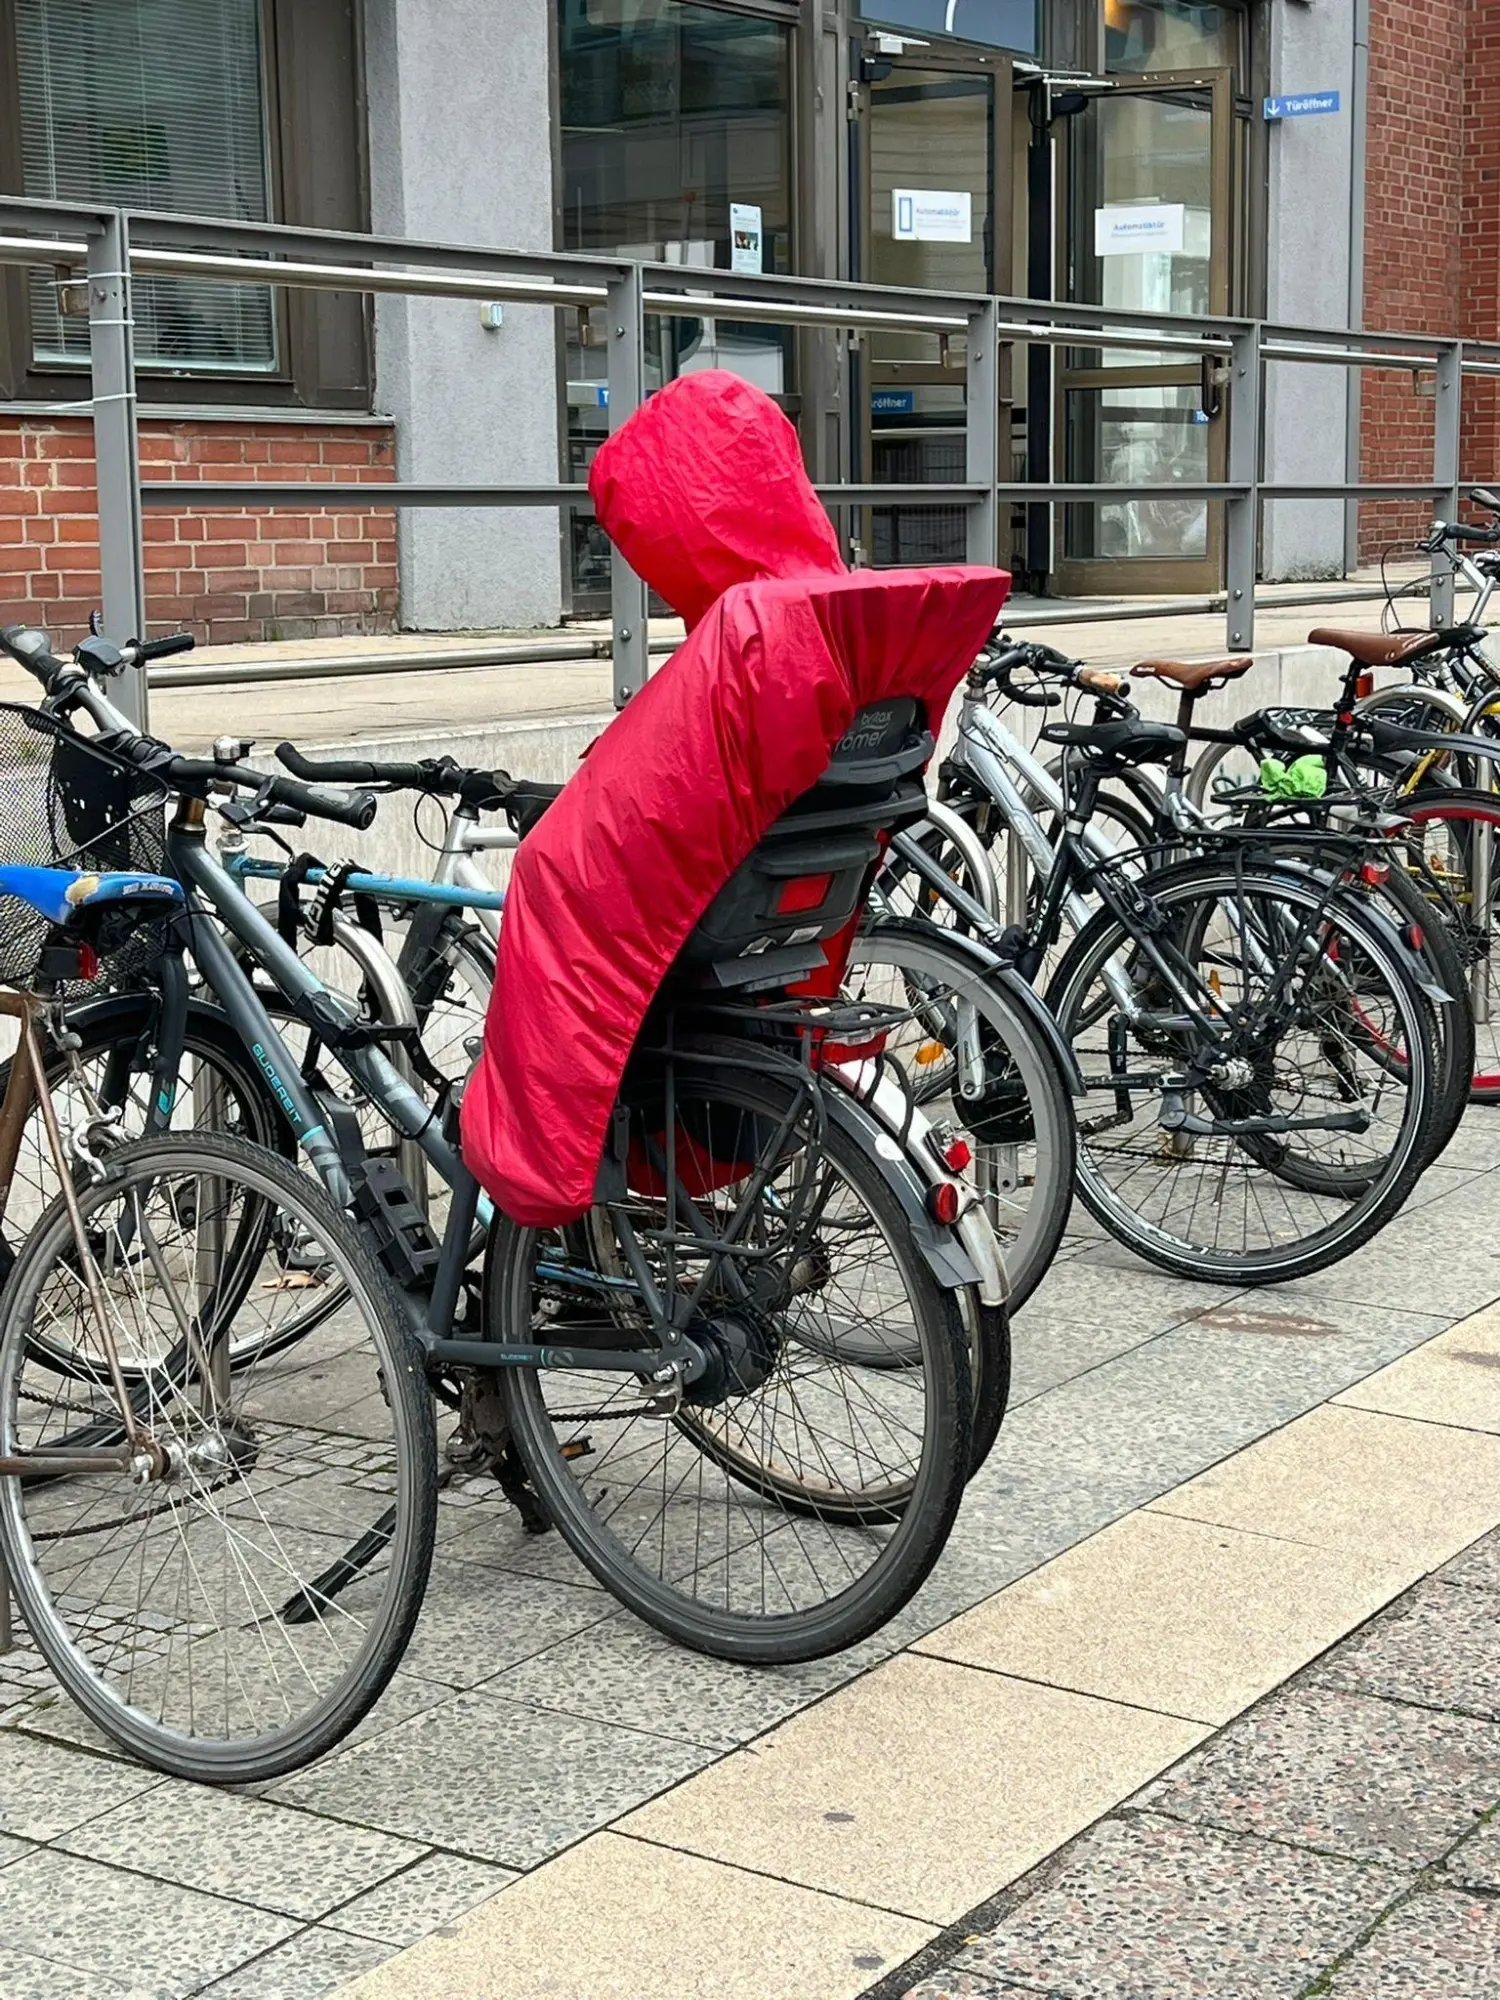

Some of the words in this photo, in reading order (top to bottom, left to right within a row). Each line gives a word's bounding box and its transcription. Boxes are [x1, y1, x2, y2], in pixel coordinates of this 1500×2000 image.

[1284, 98, 1334, 112] Türöffner
[1113, 221, 1166, 231] Automatiktür
[870, 396, 907, 409] röffner
[861, 710, 894, 725] britax
[834, 729, 888, 752] römer
[252, 1043, 302, 1123] GUDEREIT
